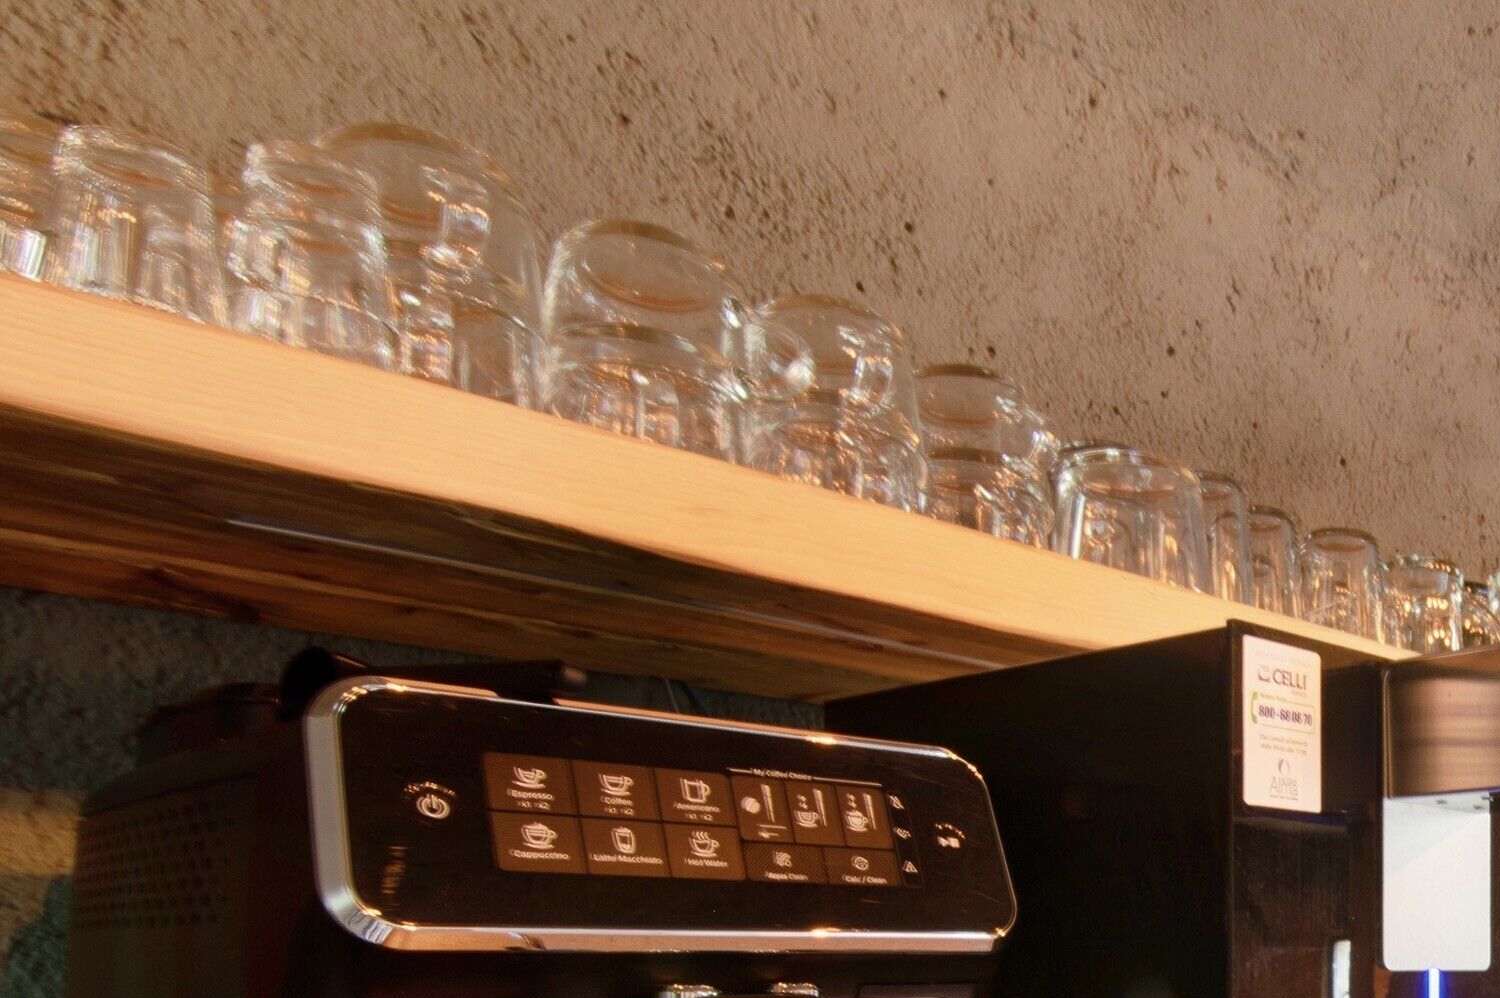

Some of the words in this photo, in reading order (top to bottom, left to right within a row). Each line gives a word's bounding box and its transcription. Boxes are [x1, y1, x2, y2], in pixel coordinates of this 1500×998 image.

[1272, 668, 1307, 690] CELLI
[753, 768, 765, 777] My
[765, 769, 788, 779] Coffee
[788, 771, 812, 781] Choice
[510, 789, 555, 801] Espresso
[537, 801, 550, 811] x2
[604, 796, 633, 806] Coffee
[676, 802, 720, 813] Americano
[512, 849, 569, 861] Cappuccino
[593, 853, 617, 863] Latte
[617, 854, 662, 865] Macchiato
[687, 858, 703, 867] Hot
[704, 859, 728, 868] Water
[843, 874, 861, 883] Calc
[866, 876, 887, 885] Clean
